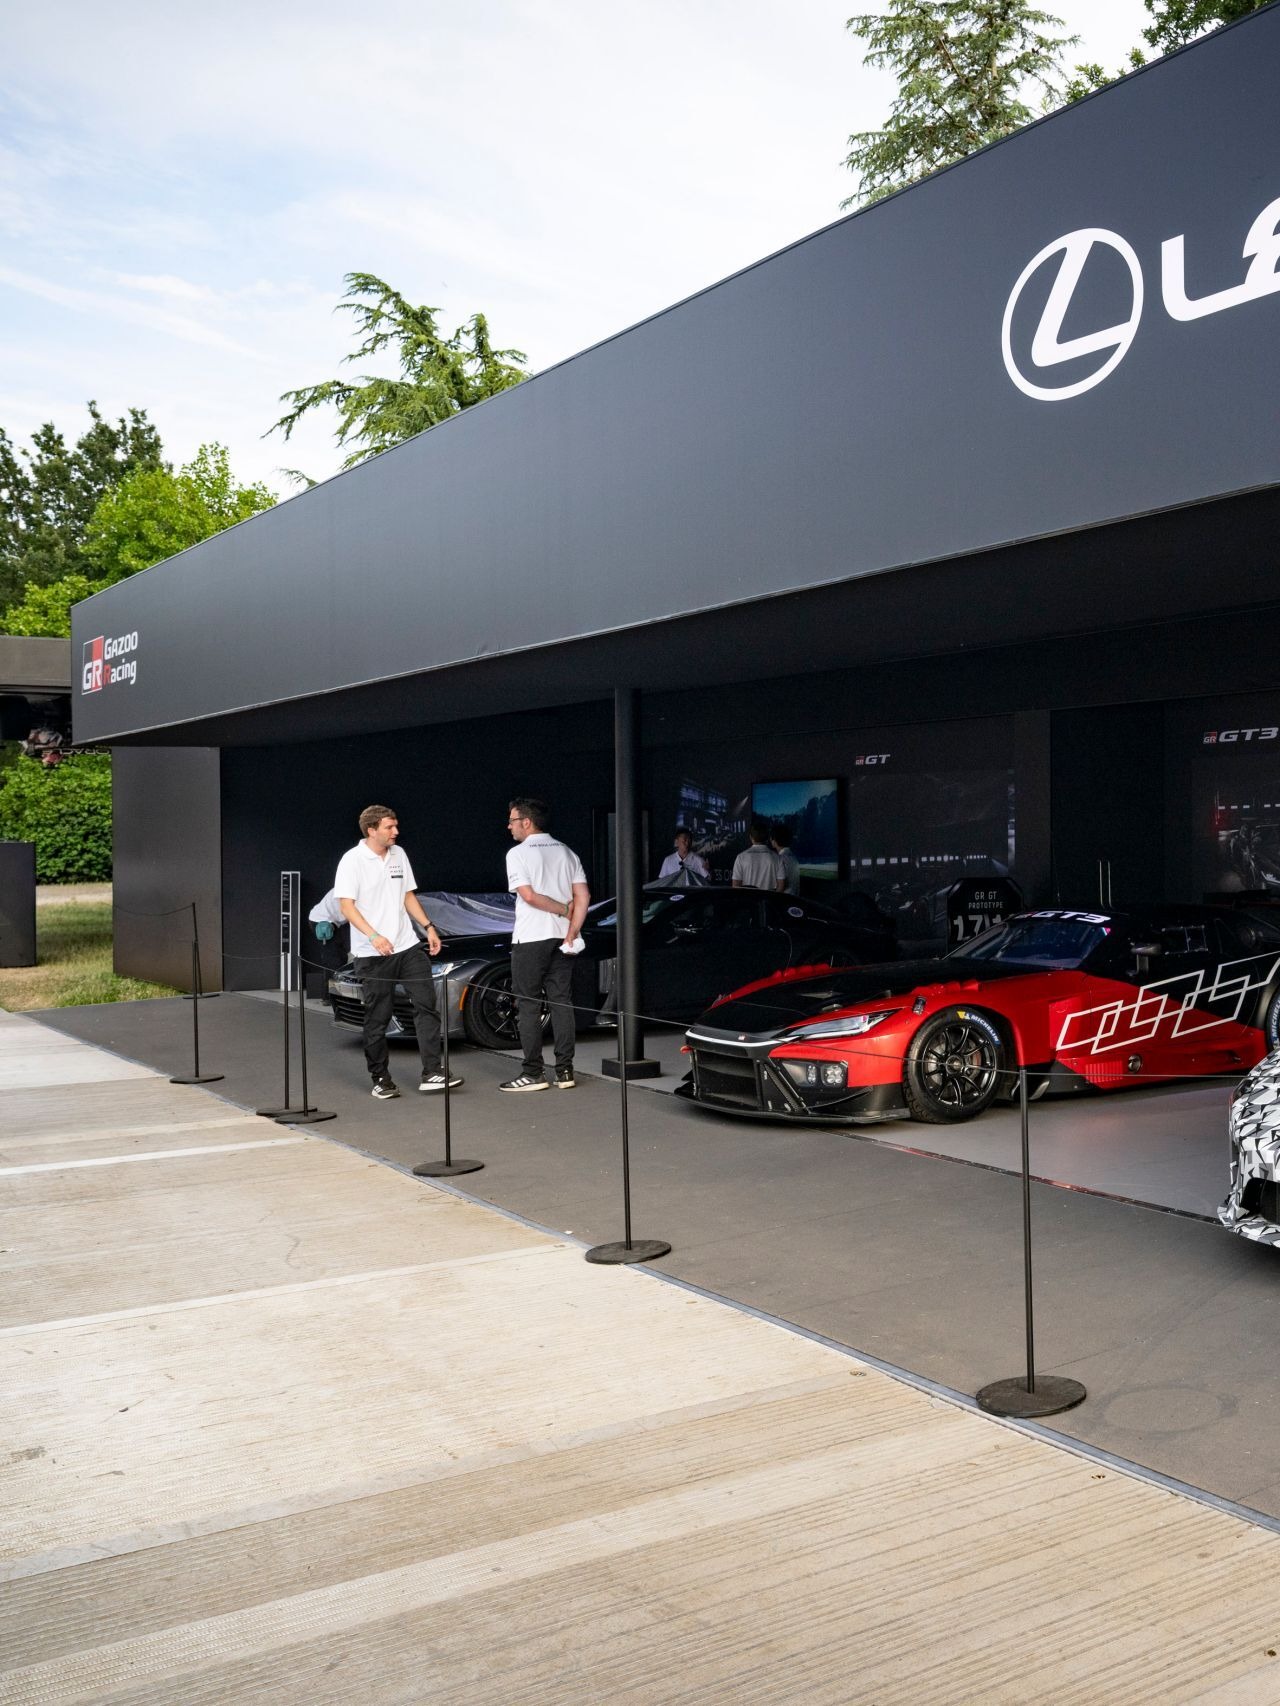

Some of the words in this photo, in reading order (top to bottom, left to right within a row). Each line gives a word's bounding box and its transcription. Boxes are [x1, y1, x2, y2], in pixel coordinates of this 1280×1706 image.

[104, 631, 139, 660] GAZOO
[83, 658, 103, 690] GR
[103, 658, 137, 685] Racing
[1218, 726, 1279, 743] GT3
[865, 754, 891, 765] GT
[974, 891, 985, 901] GR
[988, 891, 998, 901] GT
[968, 901, 1004, 910] PROTOTYPE
[1031, 910, 1112, 924] GT3
[970, 1014, 1000, 1042] MICHELIN
